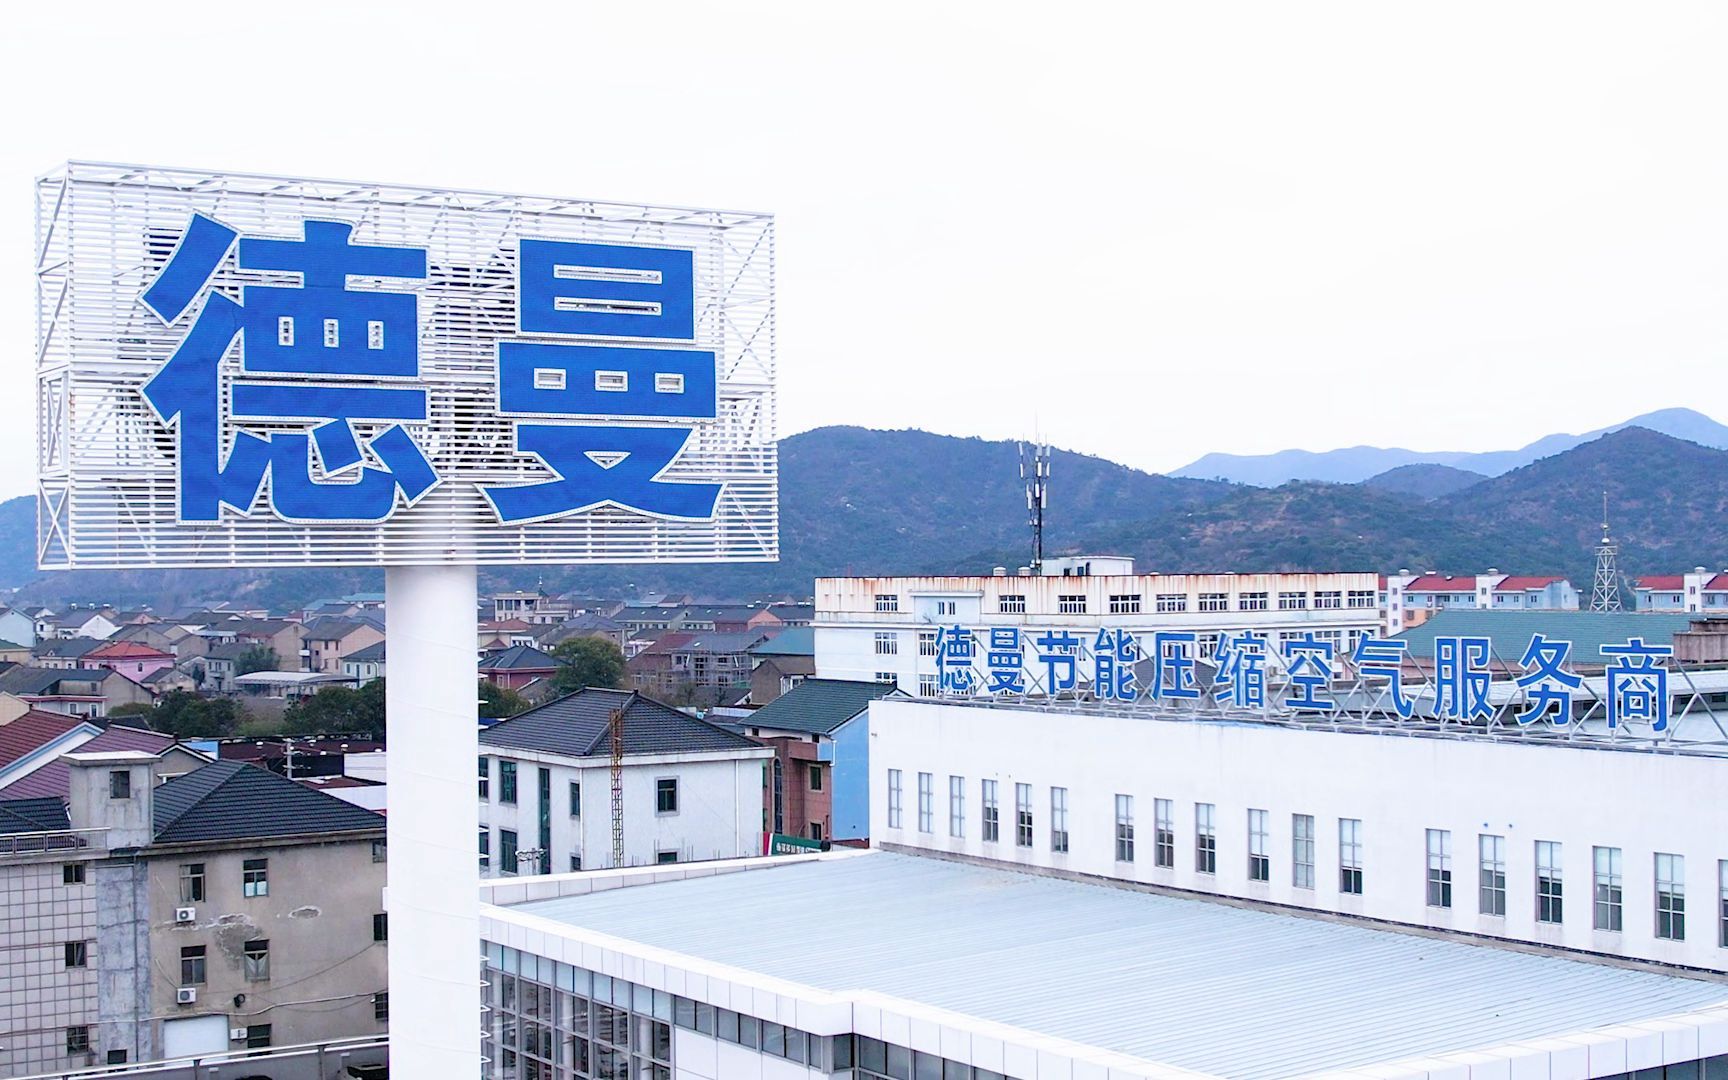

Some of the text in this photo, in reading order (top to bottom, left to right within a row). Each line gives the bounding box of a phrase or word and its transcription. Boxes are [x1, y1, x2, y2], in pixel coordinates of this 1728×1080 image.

[138, 211, 728, 527] 德曼
[934, 624, 1674, 733] 德曼节能压缩空气服务商
